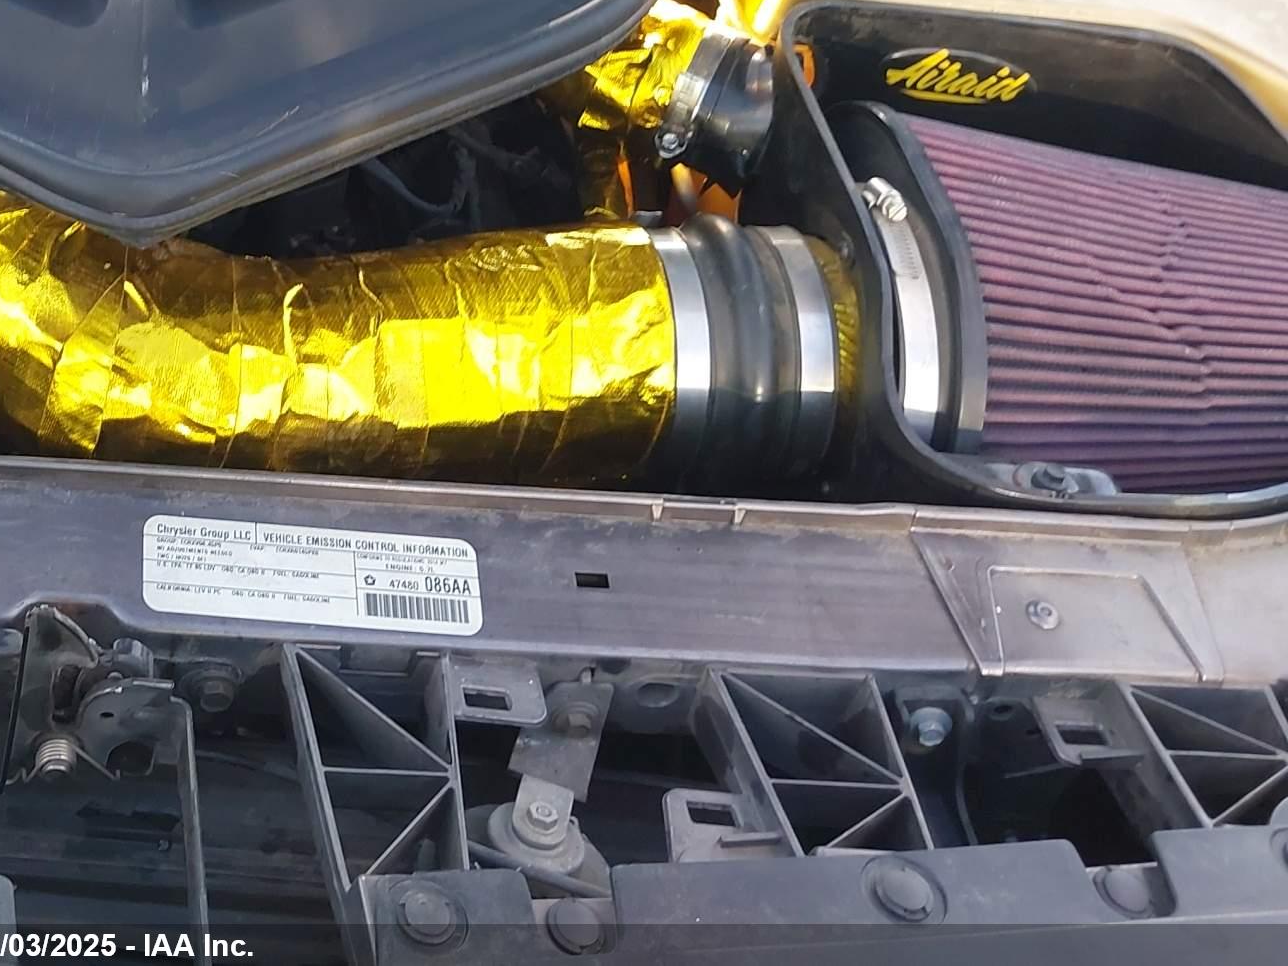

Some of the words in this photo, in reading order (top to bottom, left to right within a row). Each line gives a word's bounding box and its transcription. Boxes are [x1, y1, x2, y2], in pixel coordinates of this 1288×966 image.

[886, 48, 1030, 103] Airaid
[157, 523, 197, 537] Chrysler
[200, 527, 230, 542] Group
[233, 529, 251, 541] LLC
[263, 532, 303, 545] VEHICLE
[306, 536, 352, 548] EMISSION
[355, 539, 399, 553] CONTROL
[403, 543, 469, 558] INFORMATION
[389, 579, 419, 591] 47480
[425, 576, 471, 594] 086AA
